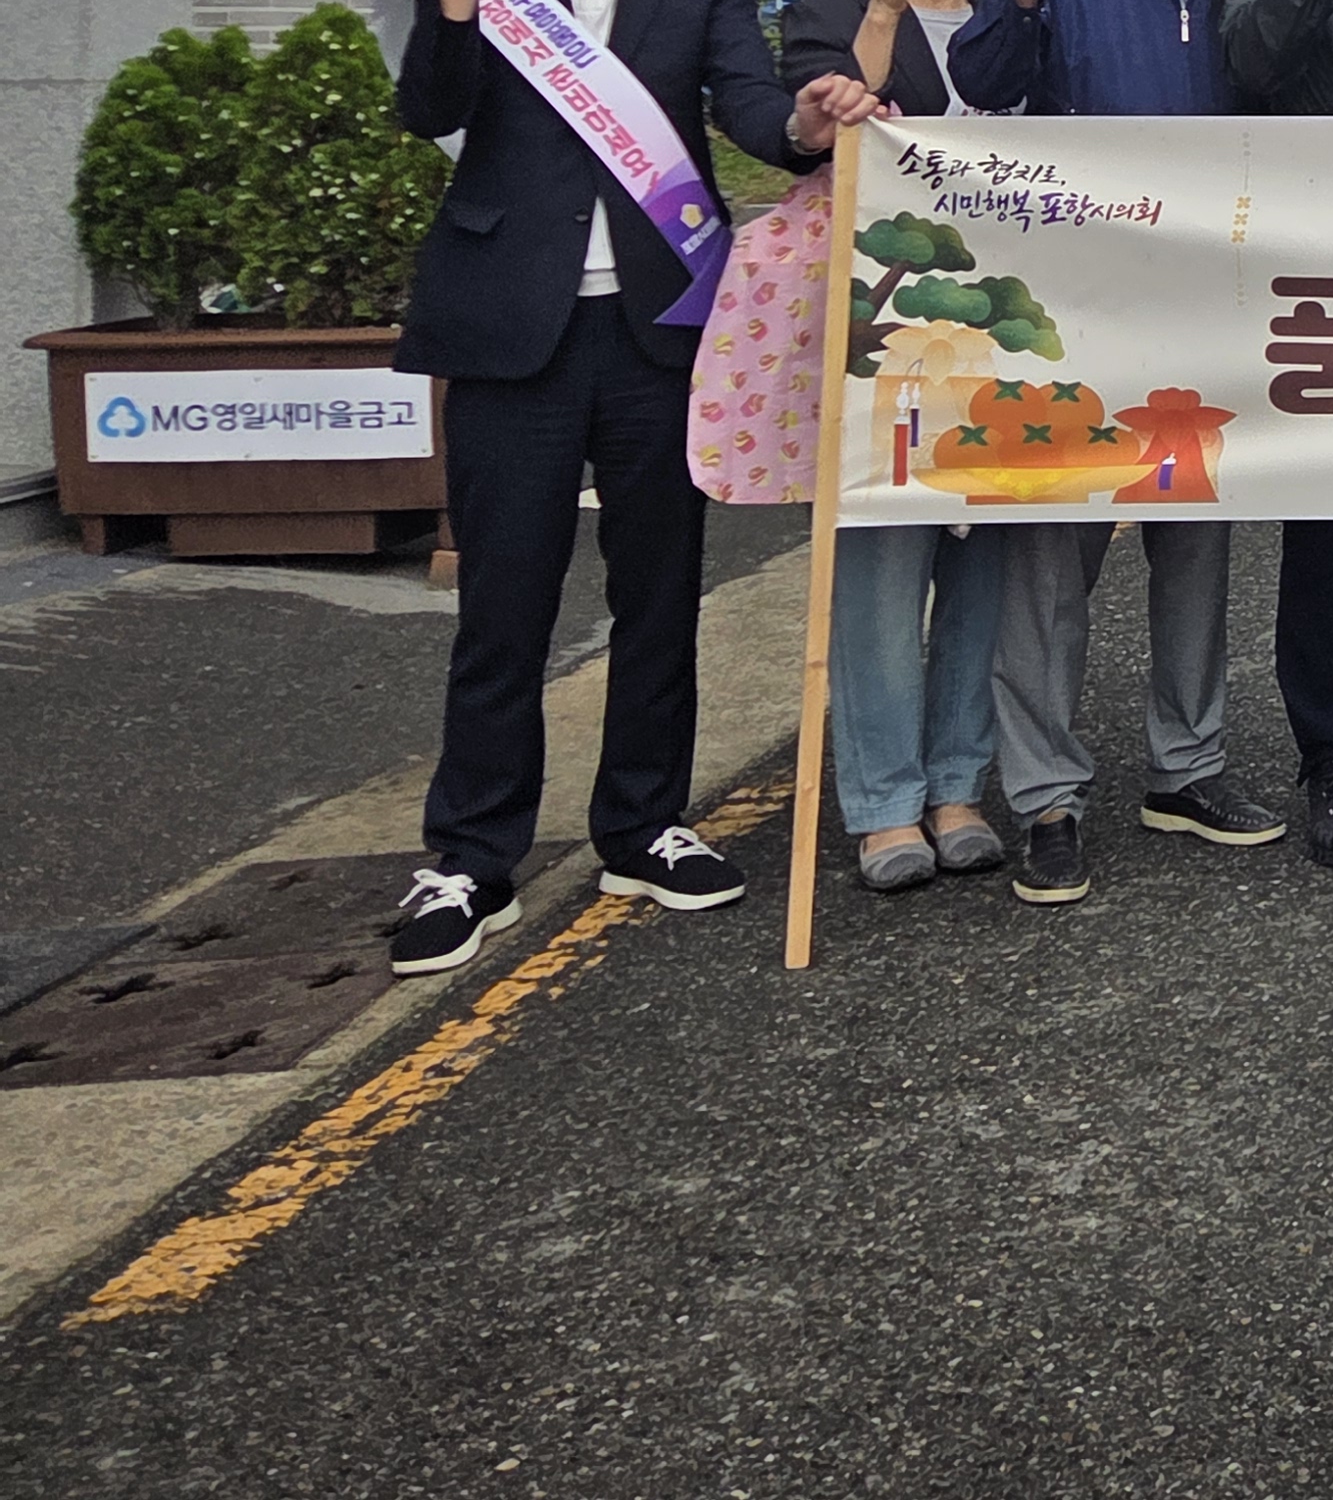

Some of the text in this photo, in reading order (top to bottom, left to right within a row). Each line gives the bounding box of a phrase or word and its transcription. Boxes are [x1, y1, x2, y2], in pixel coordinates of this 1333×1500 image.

[896, 142, 1067, 191] 소통과 협치로,
[933, 189, 1164, 233] 시민행복 포항시의회
[151, 401, 417, 431] MG영일새마을금고
